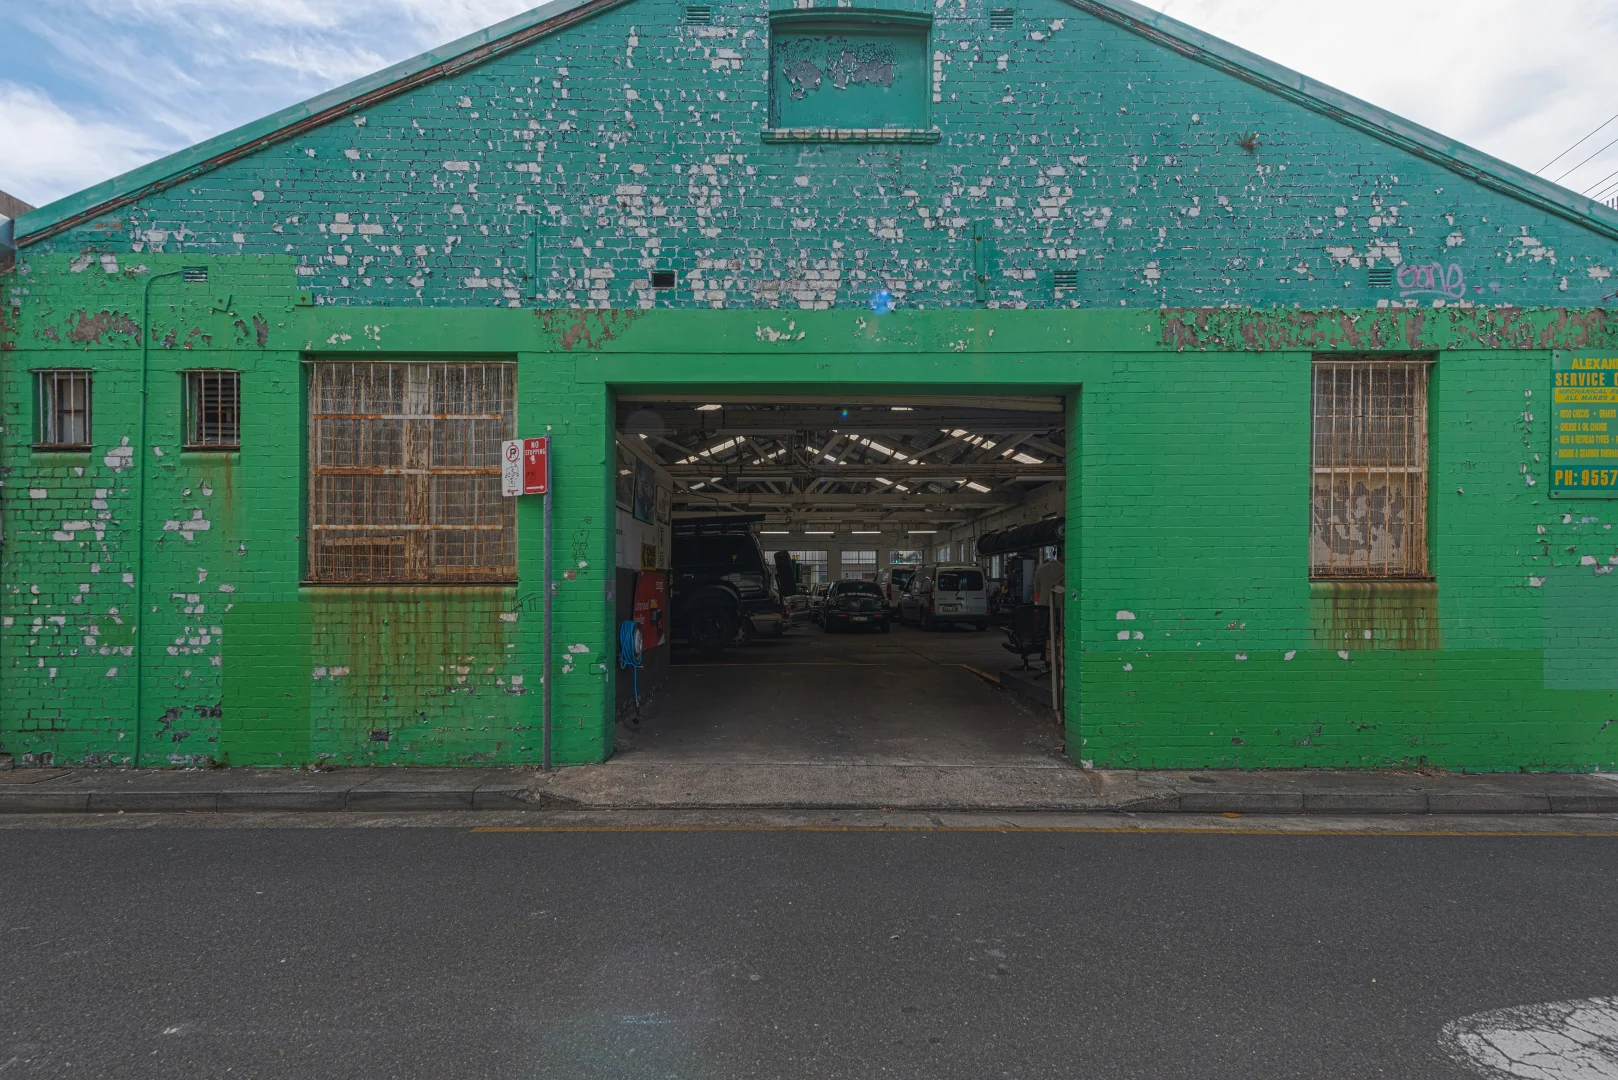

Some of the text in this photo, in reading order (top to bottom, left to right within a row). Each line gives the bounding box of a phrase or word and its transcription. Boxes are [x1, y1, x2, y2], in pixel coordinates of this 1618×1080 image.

[1555, 372, 1605, 387] SERVICE
[1560, 422, 1577, 432] GREASE
[1582, 422, 1590, 432] OIL
[1590, 422, 1608, 432] CHANGE
[1559, 434, 1570, 444] NEW
[1595, 434, 1610, 444] TYRES
[525, 448, 546, 456] STOPPING
[1558, 448, 1574, 458] ENGINE
[1579, 448, 1599, 458] GEARBOX
[1554, 469, 1618, 487] PH: 9557
